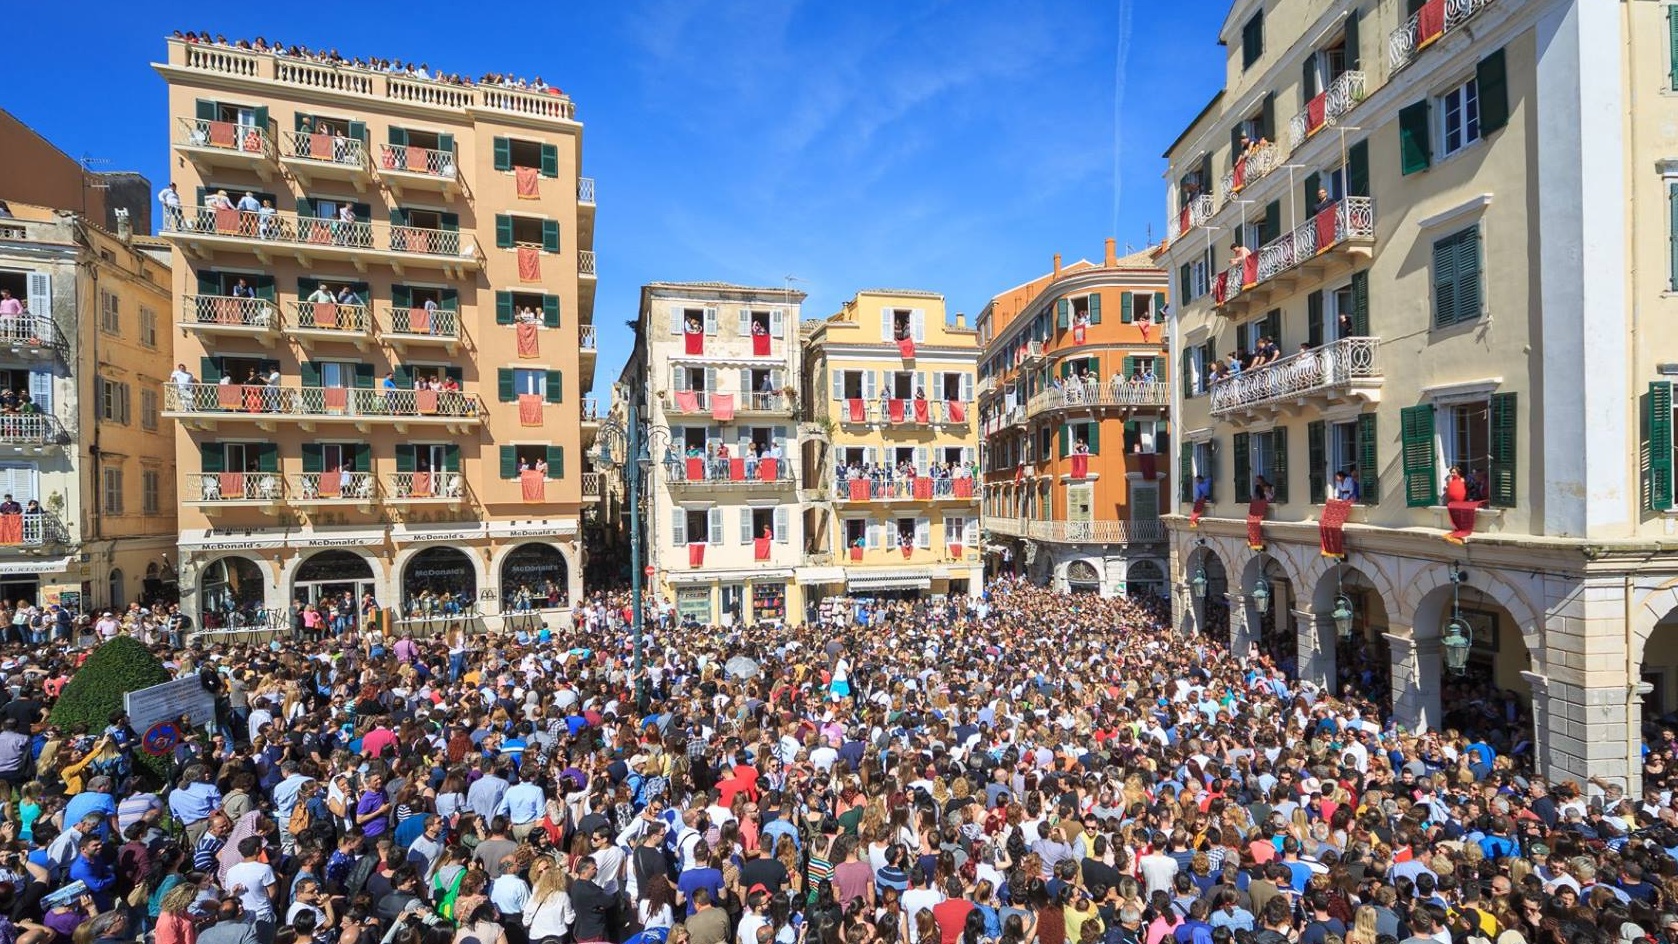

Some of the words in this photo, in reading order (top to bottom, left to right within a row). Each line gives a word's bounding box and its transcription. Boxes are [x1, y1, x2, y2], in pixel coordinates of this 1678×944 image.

[413, 533, 464, 541] McDonald's
[510, 529, 557, 537] McDonald's
[202, 541, 262, 550] McDonald's
[309, 538, 364, 547] McDonald's
